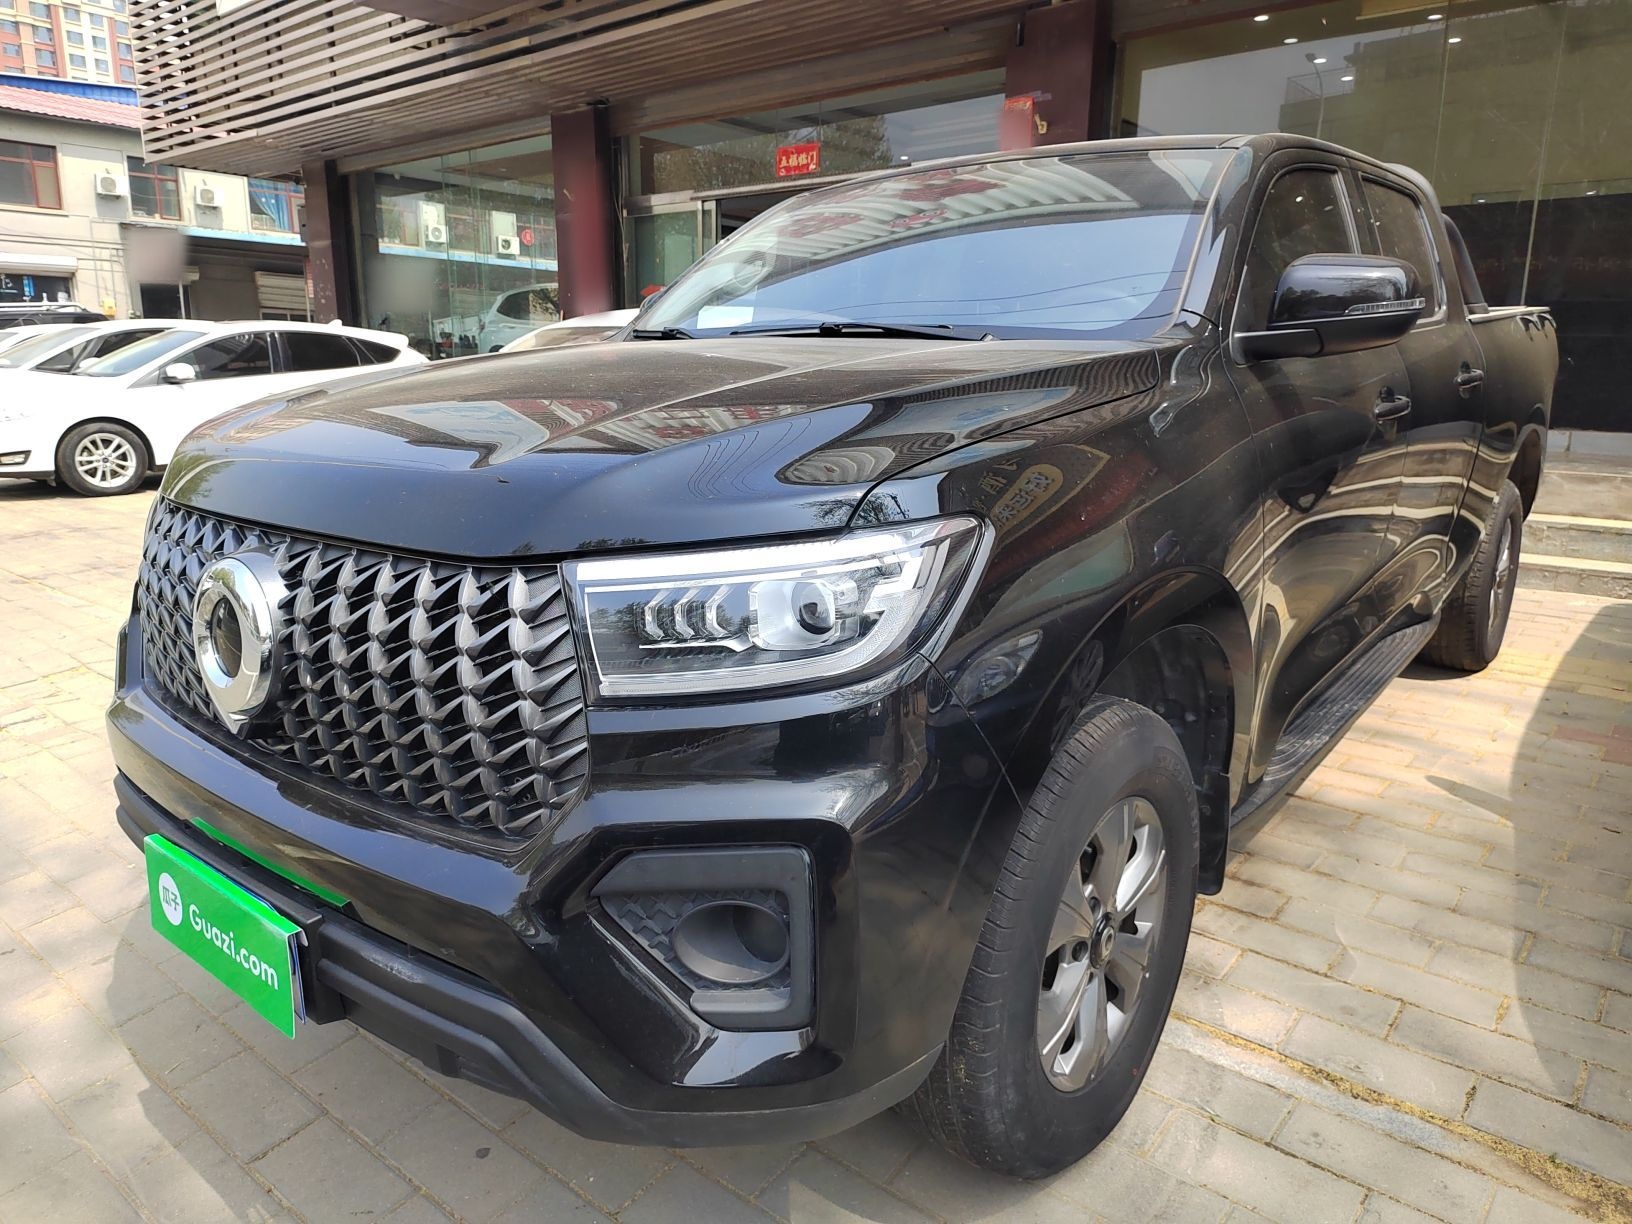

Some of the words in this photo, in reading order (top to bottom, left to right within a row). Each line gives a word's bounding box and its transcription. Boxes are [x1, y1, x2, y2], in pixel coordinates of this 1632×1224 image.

[779, 151, 816, 168] 五福临门
[162, 885, 179, 911] 瓜子
[189, 904, 279, 990] Guazi.com
